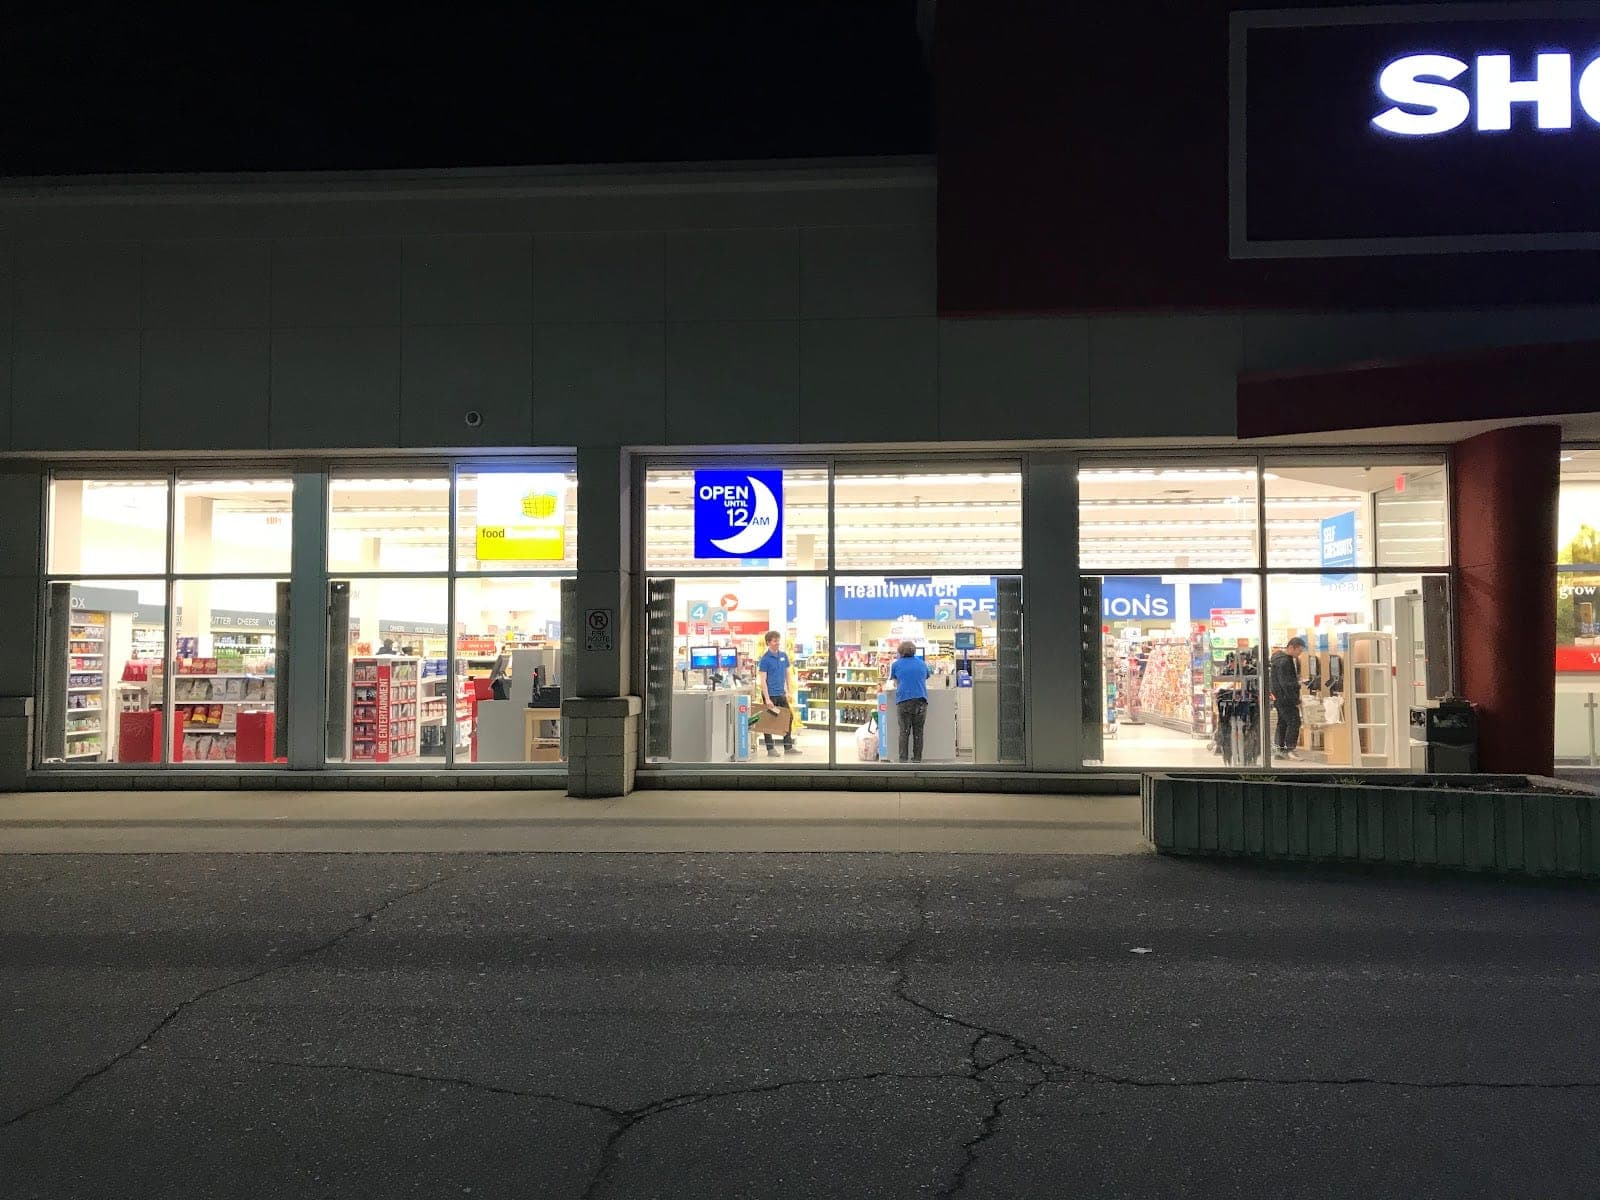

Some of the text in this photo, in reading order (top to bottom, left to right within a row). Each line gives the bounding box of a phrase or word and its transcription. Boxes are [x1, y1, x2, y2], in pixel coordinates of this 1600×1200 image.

[1371, 53, 1600, 135] SH
[700, 485, 749, 500] OPEN
[724, 500, 748, 508] UNTIL
[727, 508, 770, 527] 12 AM
[482, 528, 505, 538] food
[1323, 525, 1336, 543] SELF
[1323, 538, 1353, 560] CHECKOUTS
[1559, 585, 1597, 599] grow
[692, 606, 705, 619] 4
[1103, 597, 1169, 616] IONS
[237, 617, 259, 626] CHEESE
[713, 611, 725, 624] 3
[938, 610, 949, 622] 2
[1590, 652, 1600, 664] Y
[378, 678, 388, 738] ENTERTAINMENT
